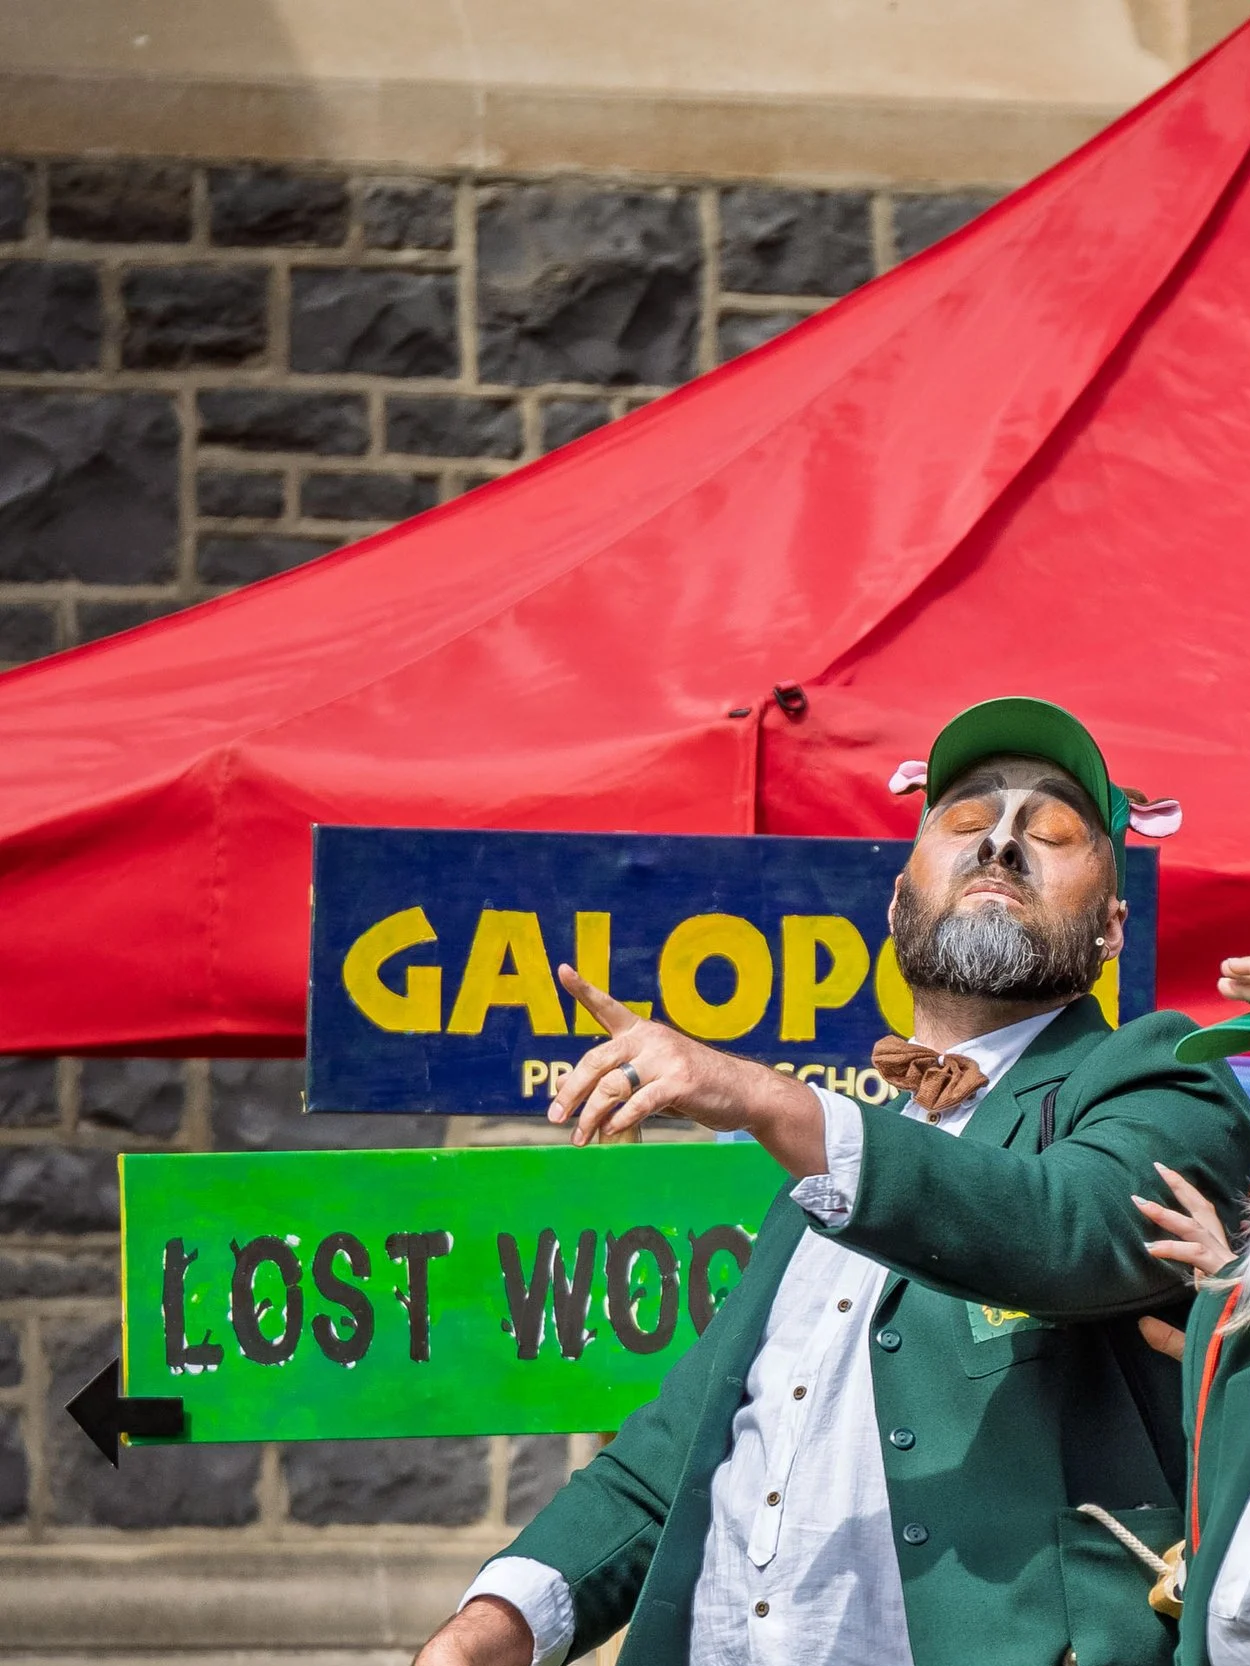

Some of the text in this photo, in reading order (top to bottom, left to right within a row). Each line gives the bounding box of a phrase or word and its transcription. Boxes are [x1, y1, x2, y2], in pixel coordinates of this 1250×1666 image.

[343, 907, 1119, 1041] GALOP
[161, 1224, 758, 1374] LOST WOO
